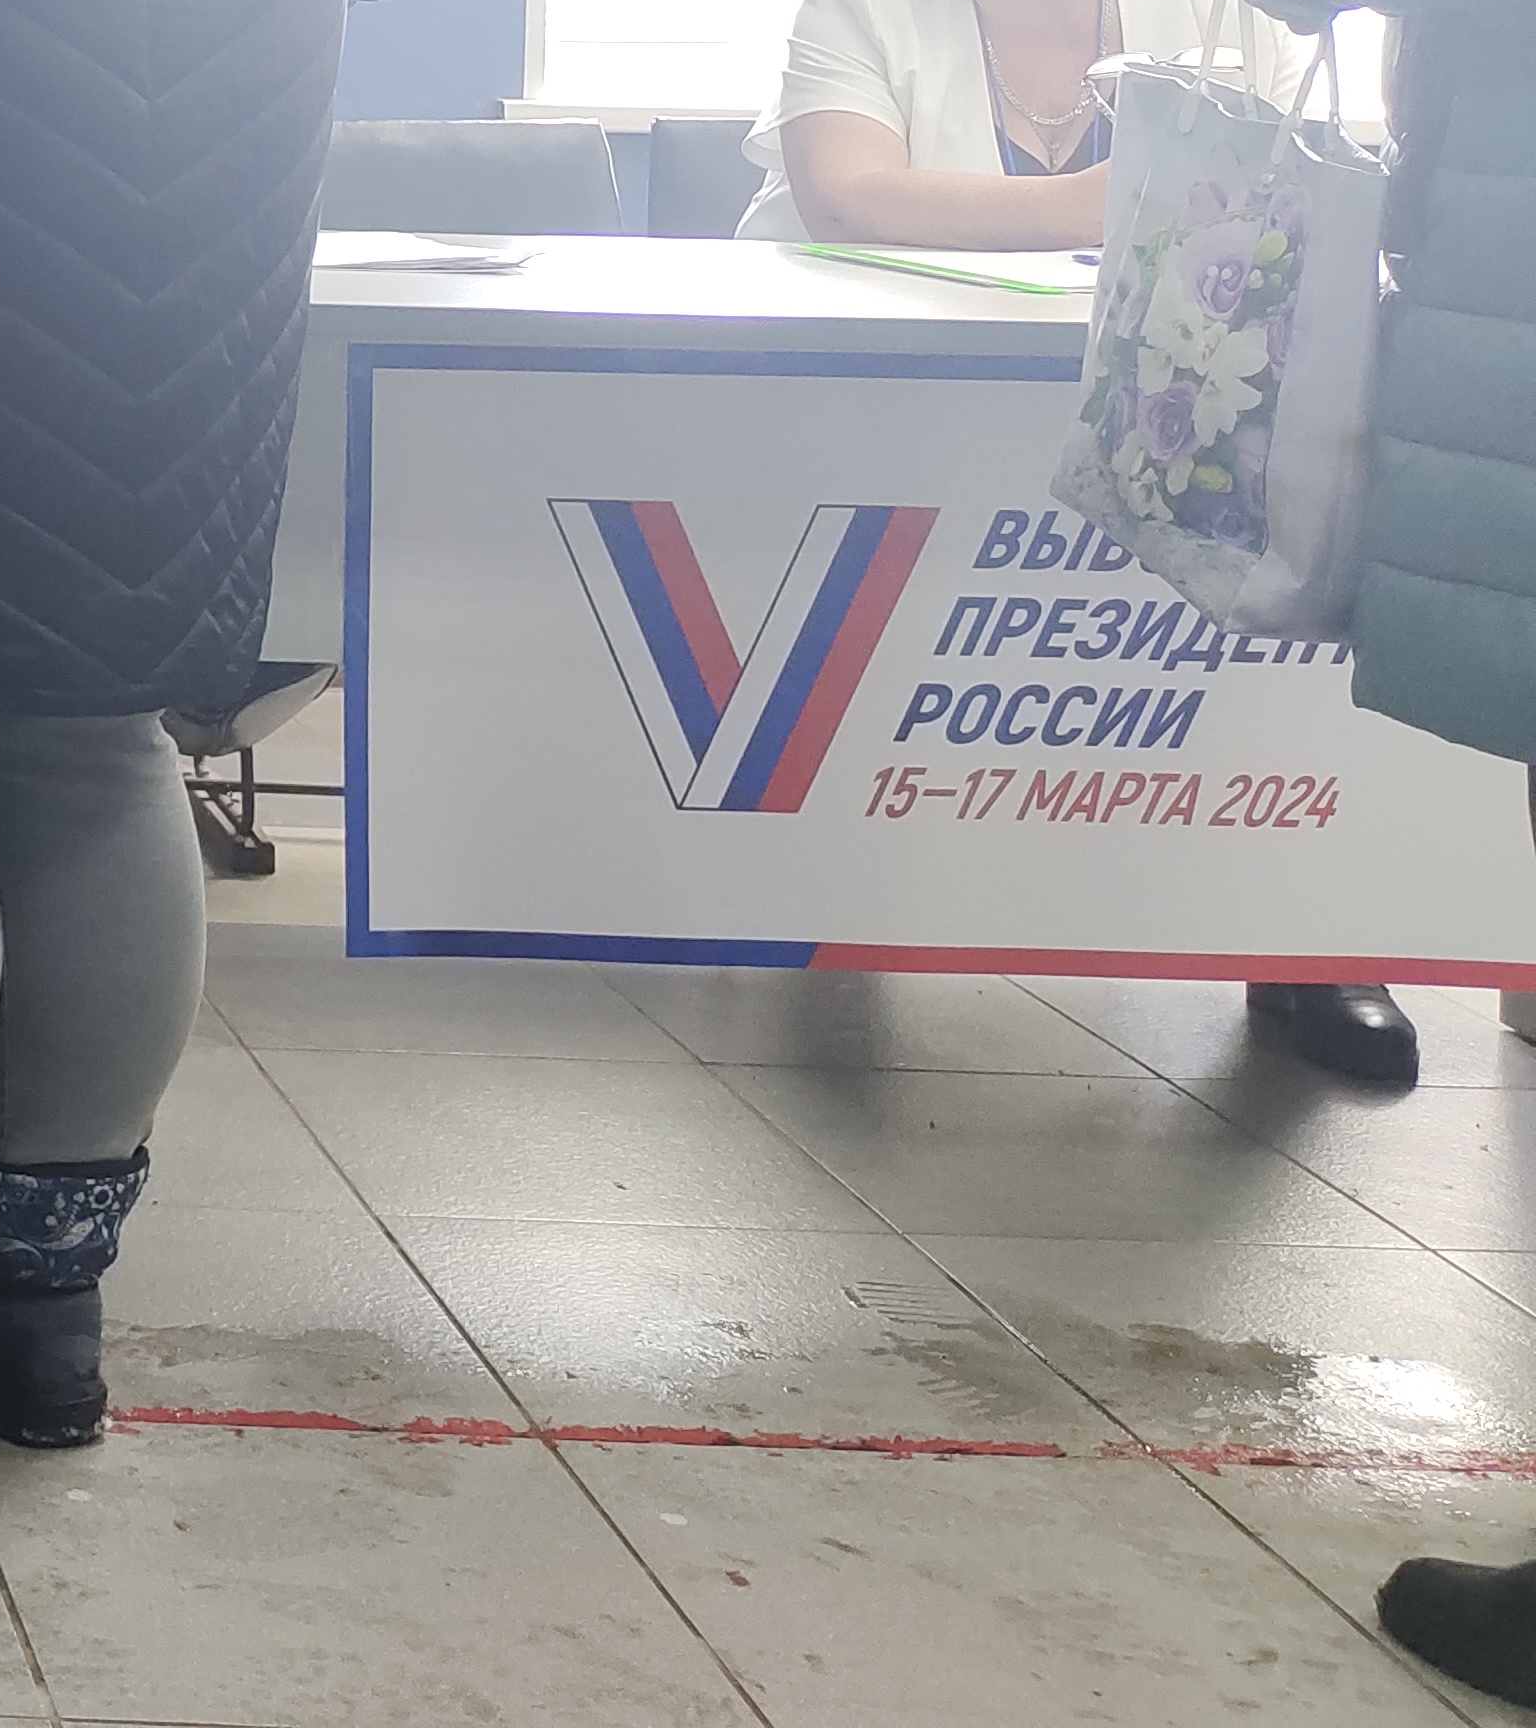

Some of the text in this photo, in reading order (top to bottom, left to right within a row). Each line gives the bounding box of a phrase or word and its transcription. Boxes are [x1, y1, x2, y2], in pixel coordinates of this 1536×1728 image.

[893, 683, 1206, 749] РОССИИ
[1016, 768, 1202, 827] МАРТА
[1208, 774, 1341, 829] 2024
